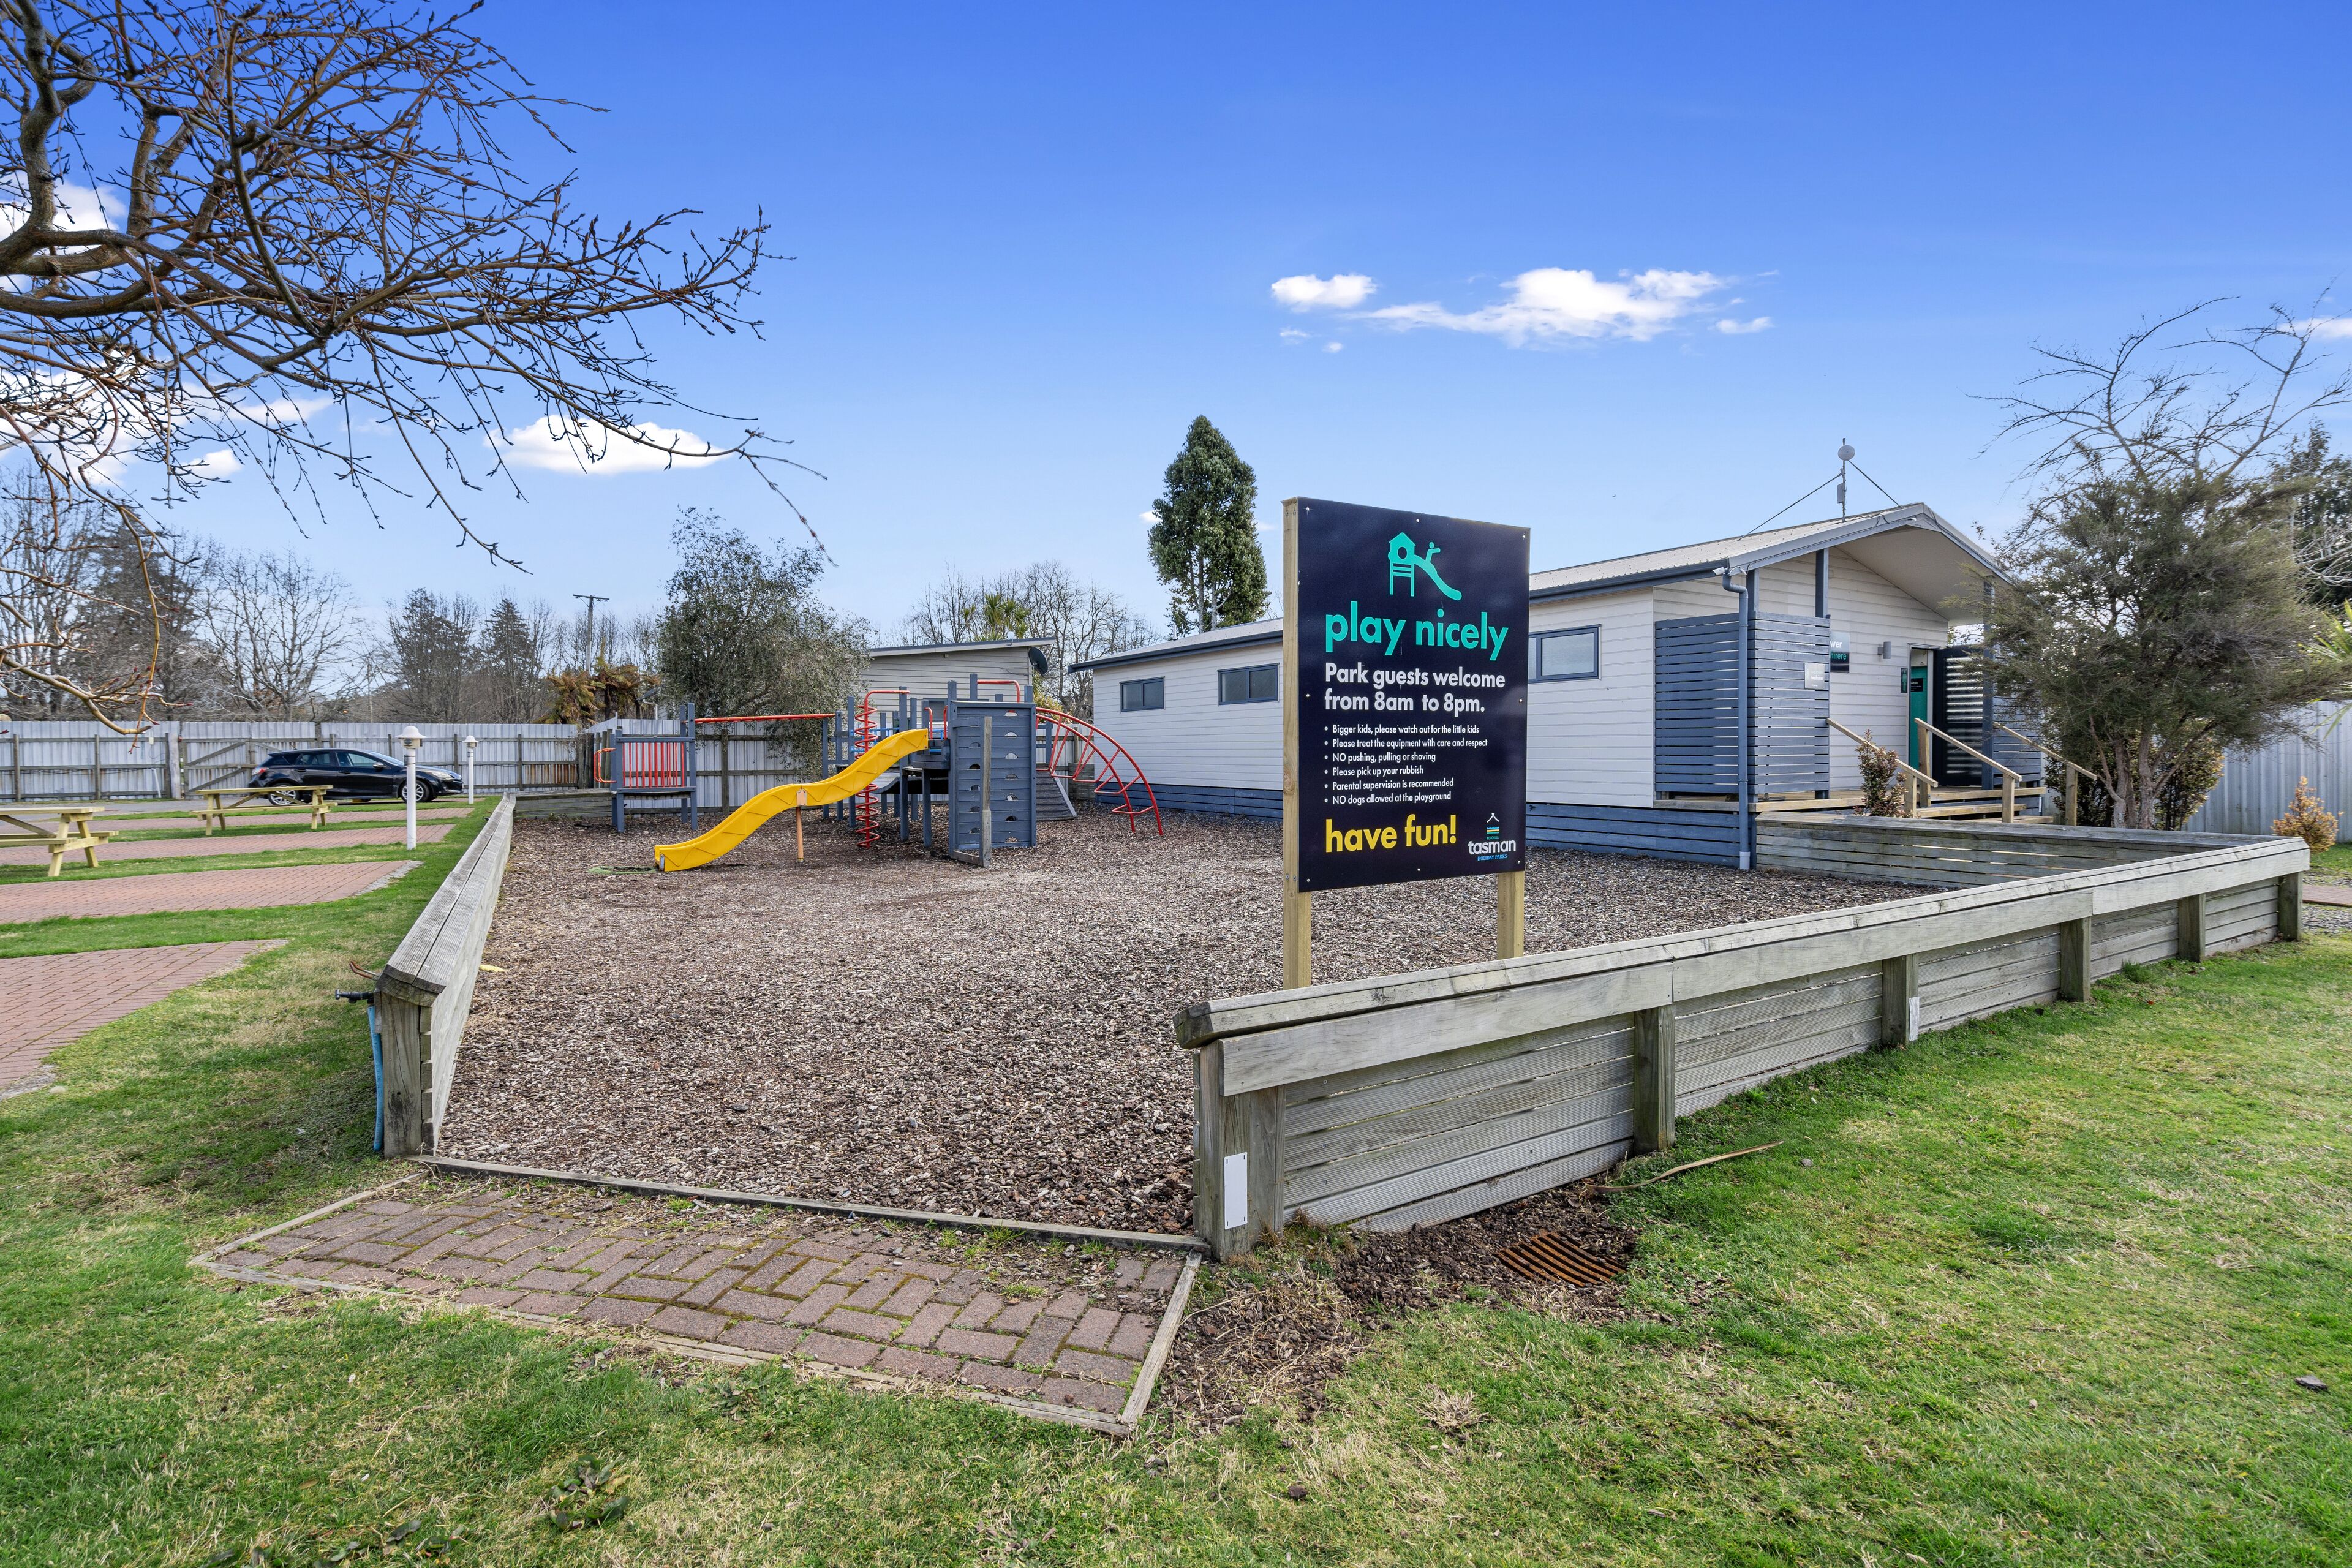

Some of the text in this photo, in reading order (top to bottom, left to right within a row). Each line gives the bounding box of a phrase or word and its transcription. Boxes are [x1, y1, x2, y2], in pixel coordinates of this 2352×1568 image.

[1325, 601, 1509, 661] play nicely
[1325, 662, 1506, 690] Park guests welcome
[1325, 688, 1485, 718] from 8am to 8pm.
[1332, 723, 1480, 736] Bigger kids, please watch out for the little kids
[1332, 737, 1355, 748] Please
[1357, 739, 1373, 748] treat
[1374, 737, 1385, 747] the
[1386, 738, 1422, 750] equipment
[1422, 737, 1436, 747] with
[1452, 737, 1464, 747] and
[1465, 739, 1488, 749] respect
[1332, 753, 1347, 762] NO
[1348, 752, 1377, 764] pushing,
[1378, 751, 1401, 764] pulling
[1411, 751, 1436, 763] shoving
[1332, 764, 1424, 778] Please pick up your rubbish
[1332, 777, 1454, 792] Parental supervision is recommended
[1332, 790, 1452, 806] NO dogs allowed at the playground
[1325, 813, 1457, 853] have fun!
[1468, 840, 1517, 855] tasman
